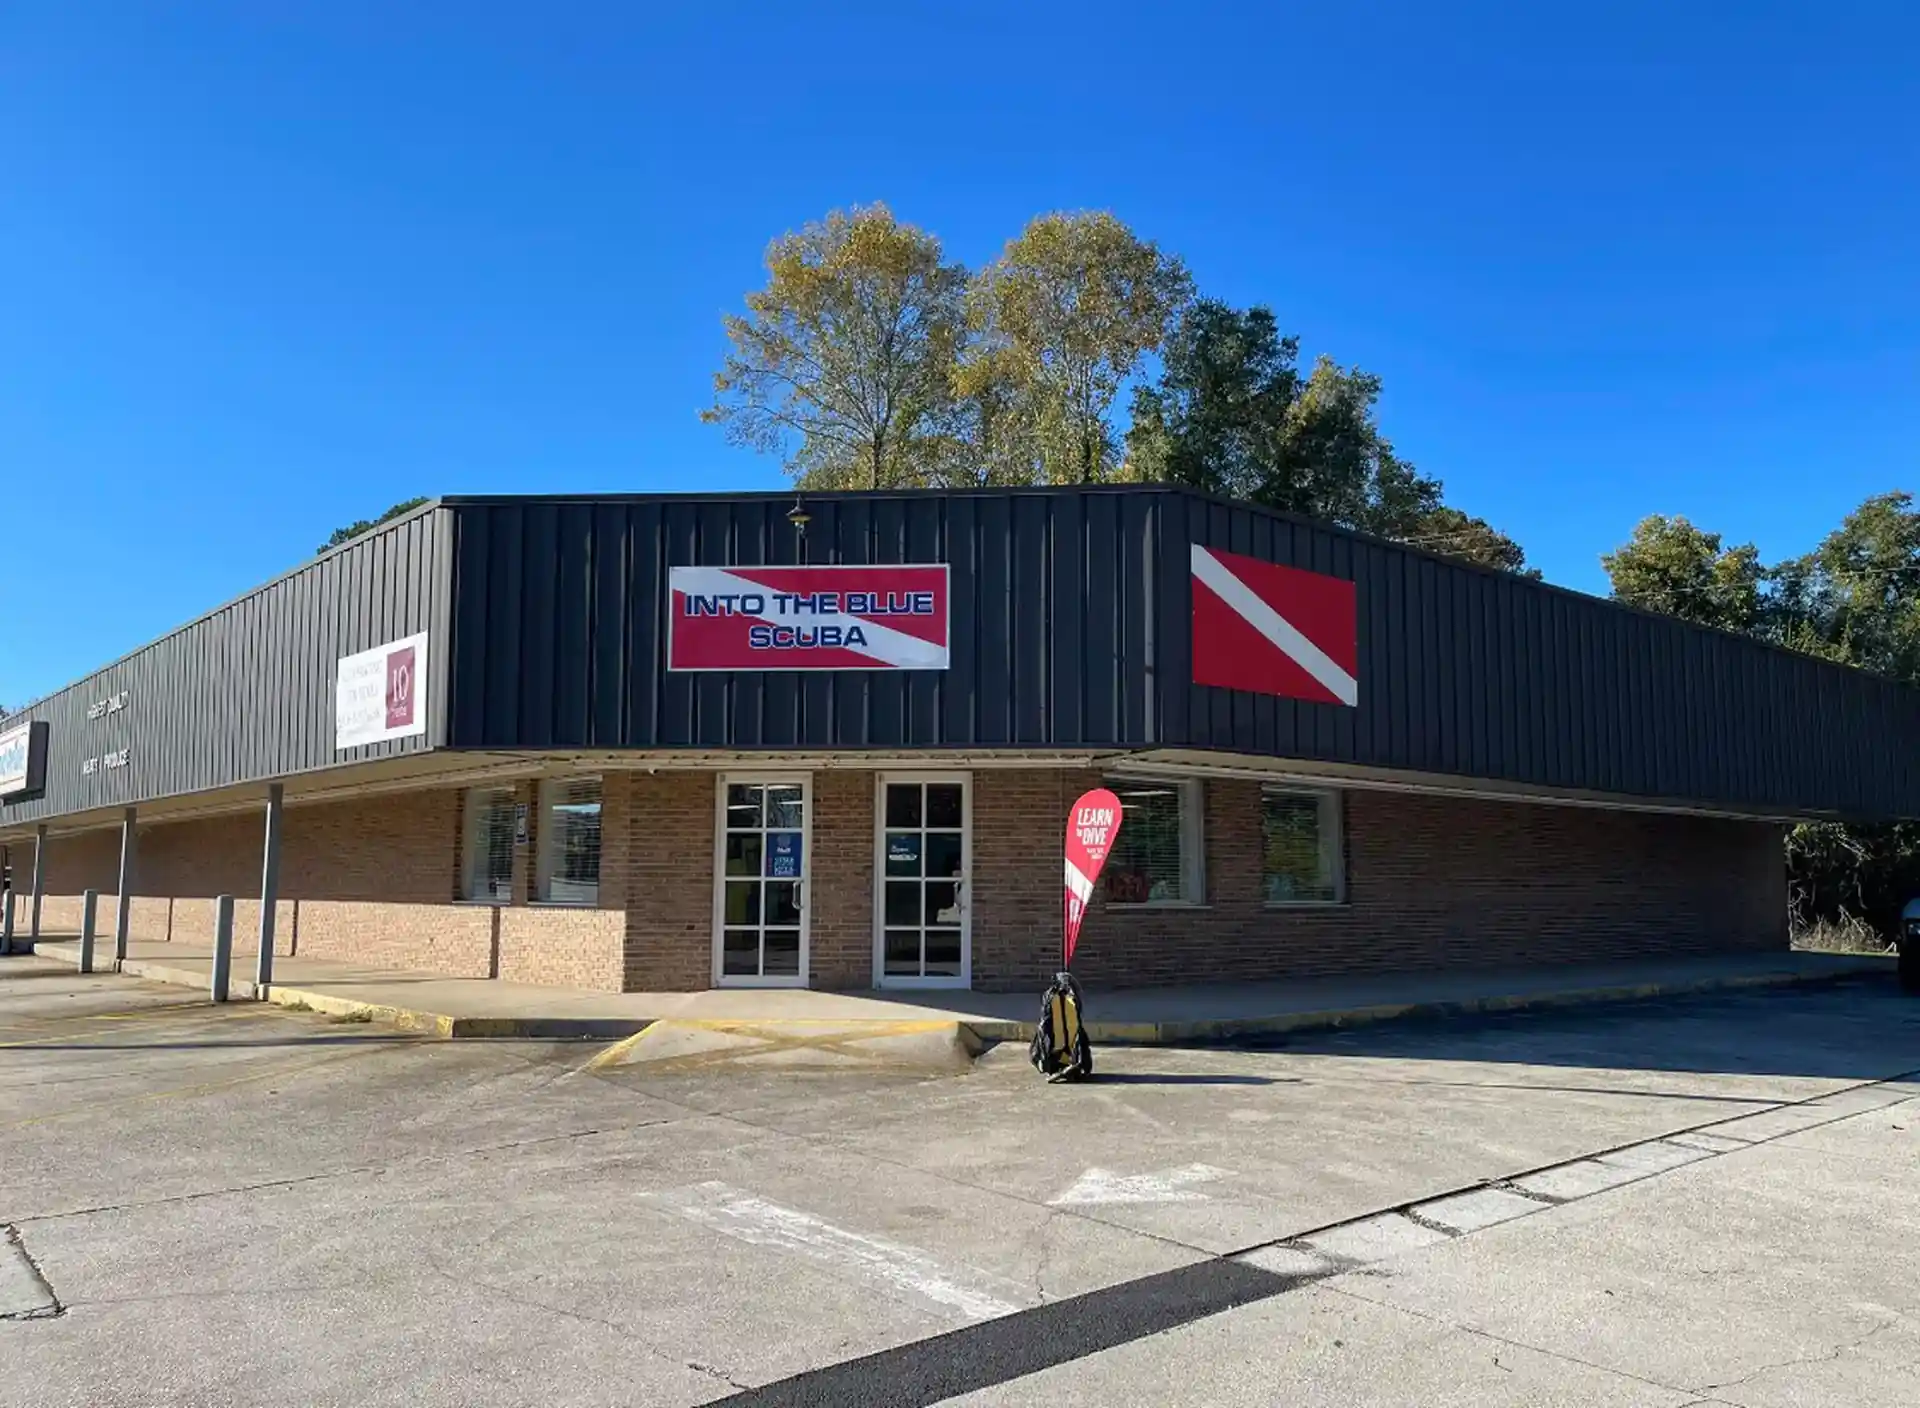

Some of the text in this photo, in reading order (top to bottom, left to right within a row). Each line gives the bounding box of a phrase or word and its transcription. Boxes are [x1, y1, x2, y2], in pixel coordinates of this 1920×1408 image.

[685, 592, 933, 616] INTO THE BLUE
[749, 625, 868, 648] SCUBA
[1077, 808, 1113, 826] LEARN
[1082, 827, 1108, 846] DIVE
